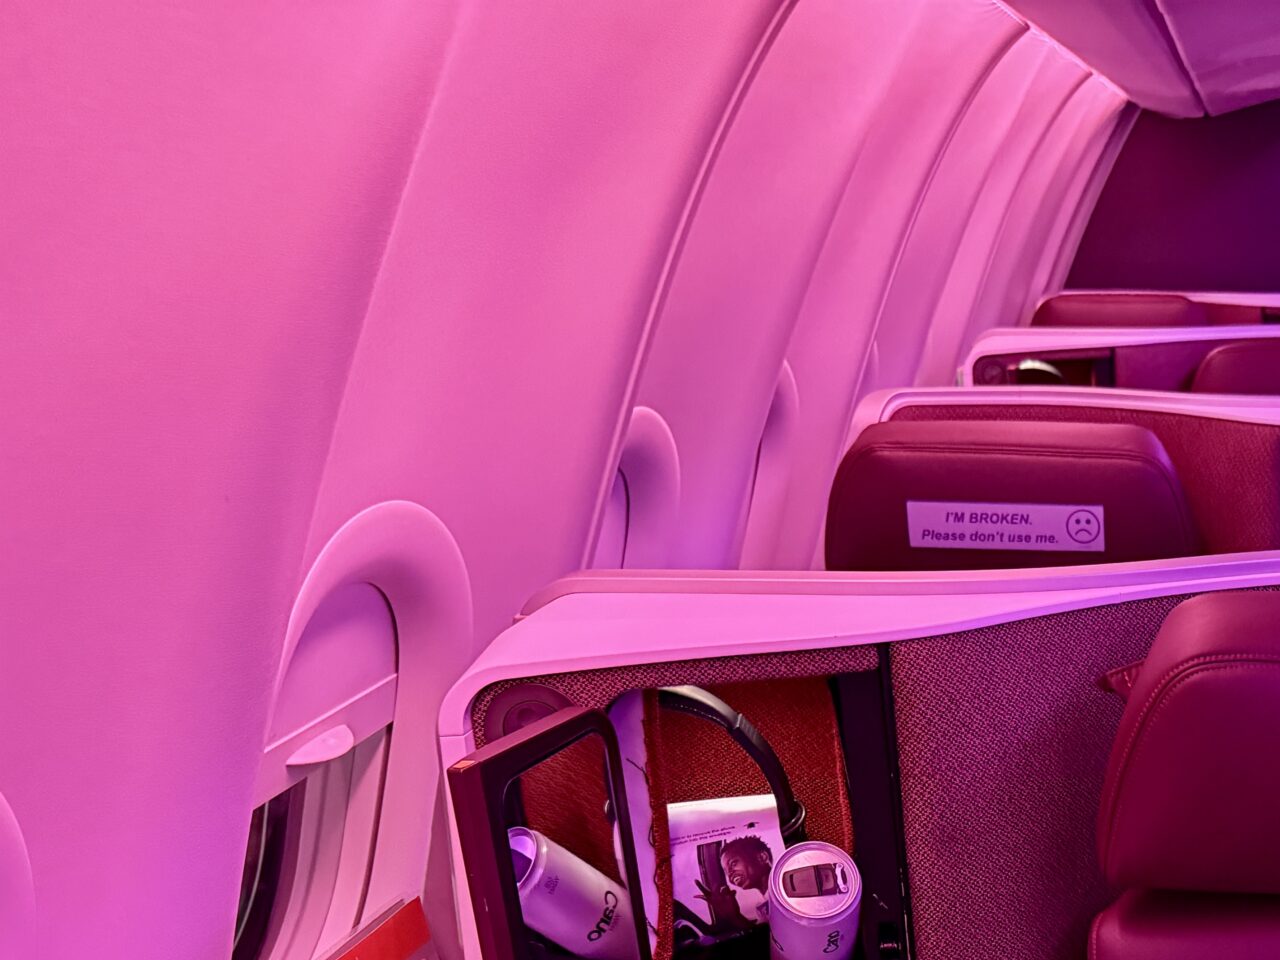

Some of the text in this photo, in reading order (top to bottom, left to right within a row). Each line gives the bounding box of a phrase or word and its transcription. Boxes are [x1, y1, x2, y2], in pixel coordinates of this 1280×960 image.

[945, 511, 1033, 526] I'M BROKEN.
[921, 529, 1059, 544] Please don't use me.
